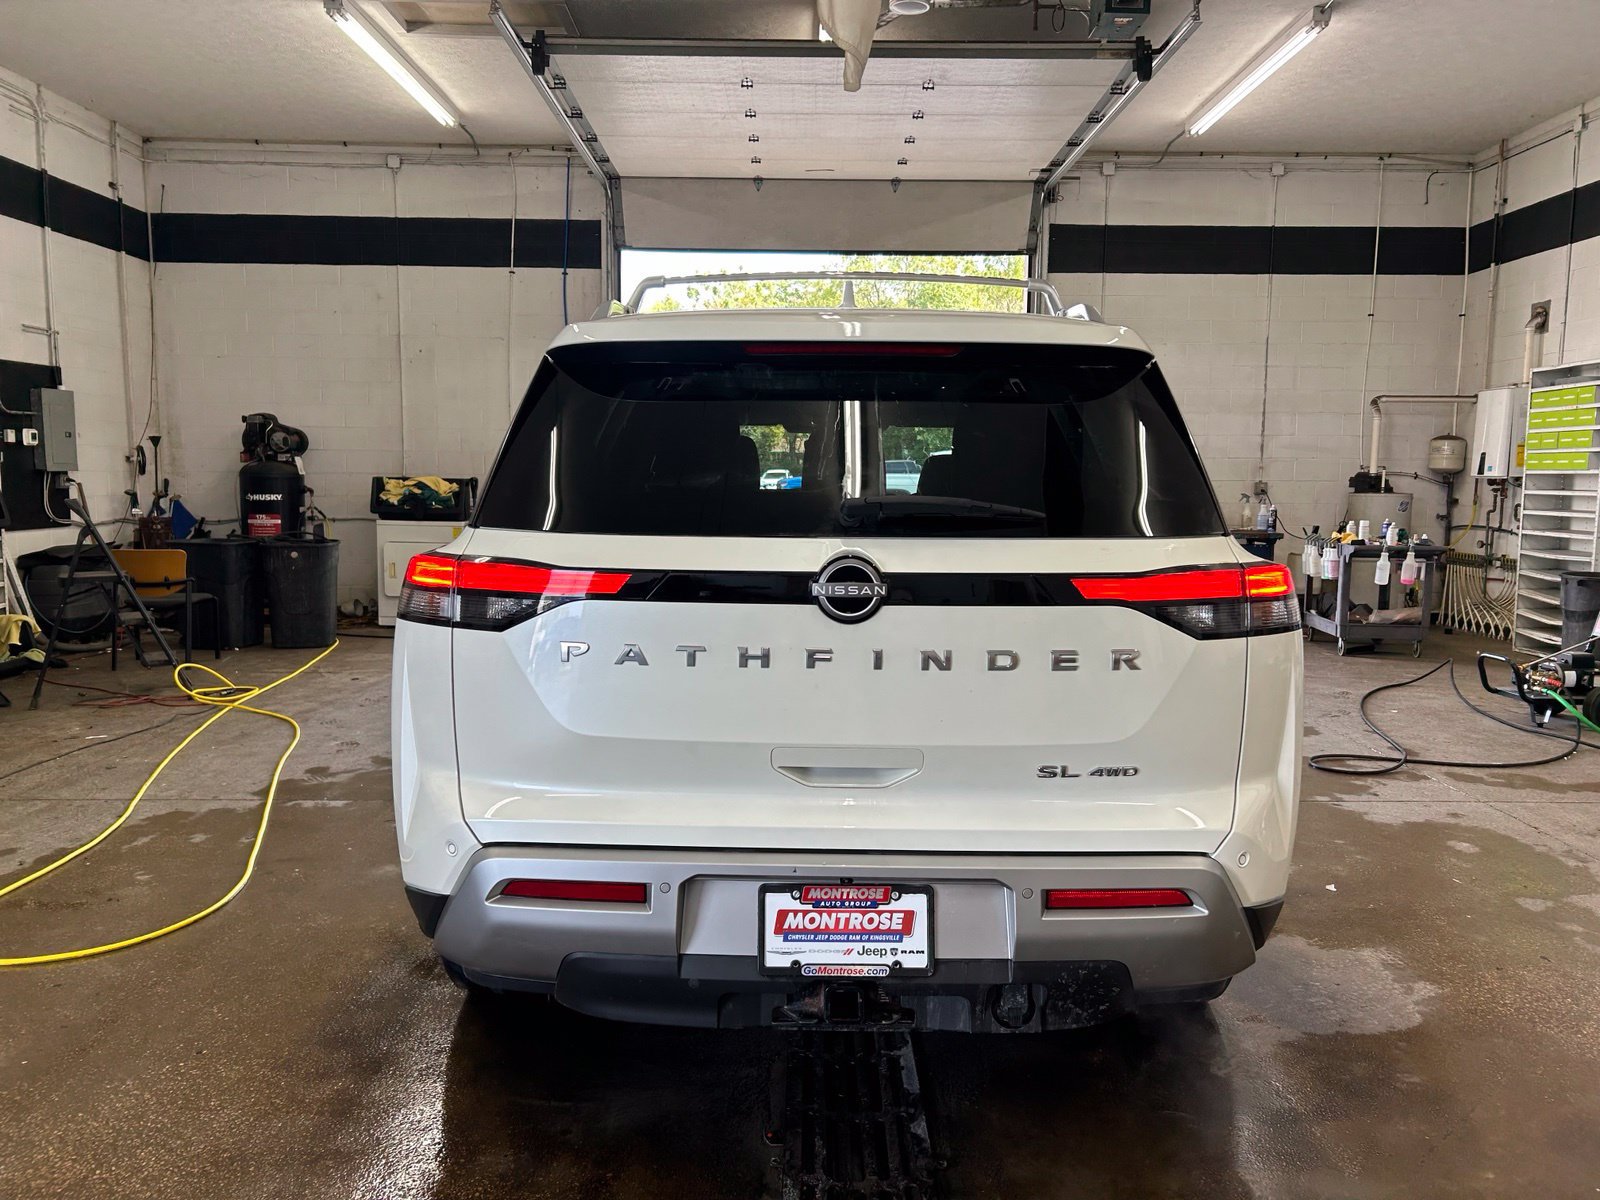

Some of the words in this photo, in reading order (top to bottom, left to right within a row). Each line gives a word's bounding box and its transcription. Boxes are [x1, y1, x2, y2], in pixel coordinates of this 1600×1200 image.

[814, 586, 886, 595] NISSAN
[559, 640, 1142, 671] PATHFINDER
[1037, 765, 1081, 778] SL
[1088, 767, 1139, 777] 4WD
[808, 888, 884, 899] MONTROSE
[783, 912, 905, 930] MONTROSE
[857, 945, 888, 958] Jeep
[803, 966, 888, 976] GoMontrose.com
